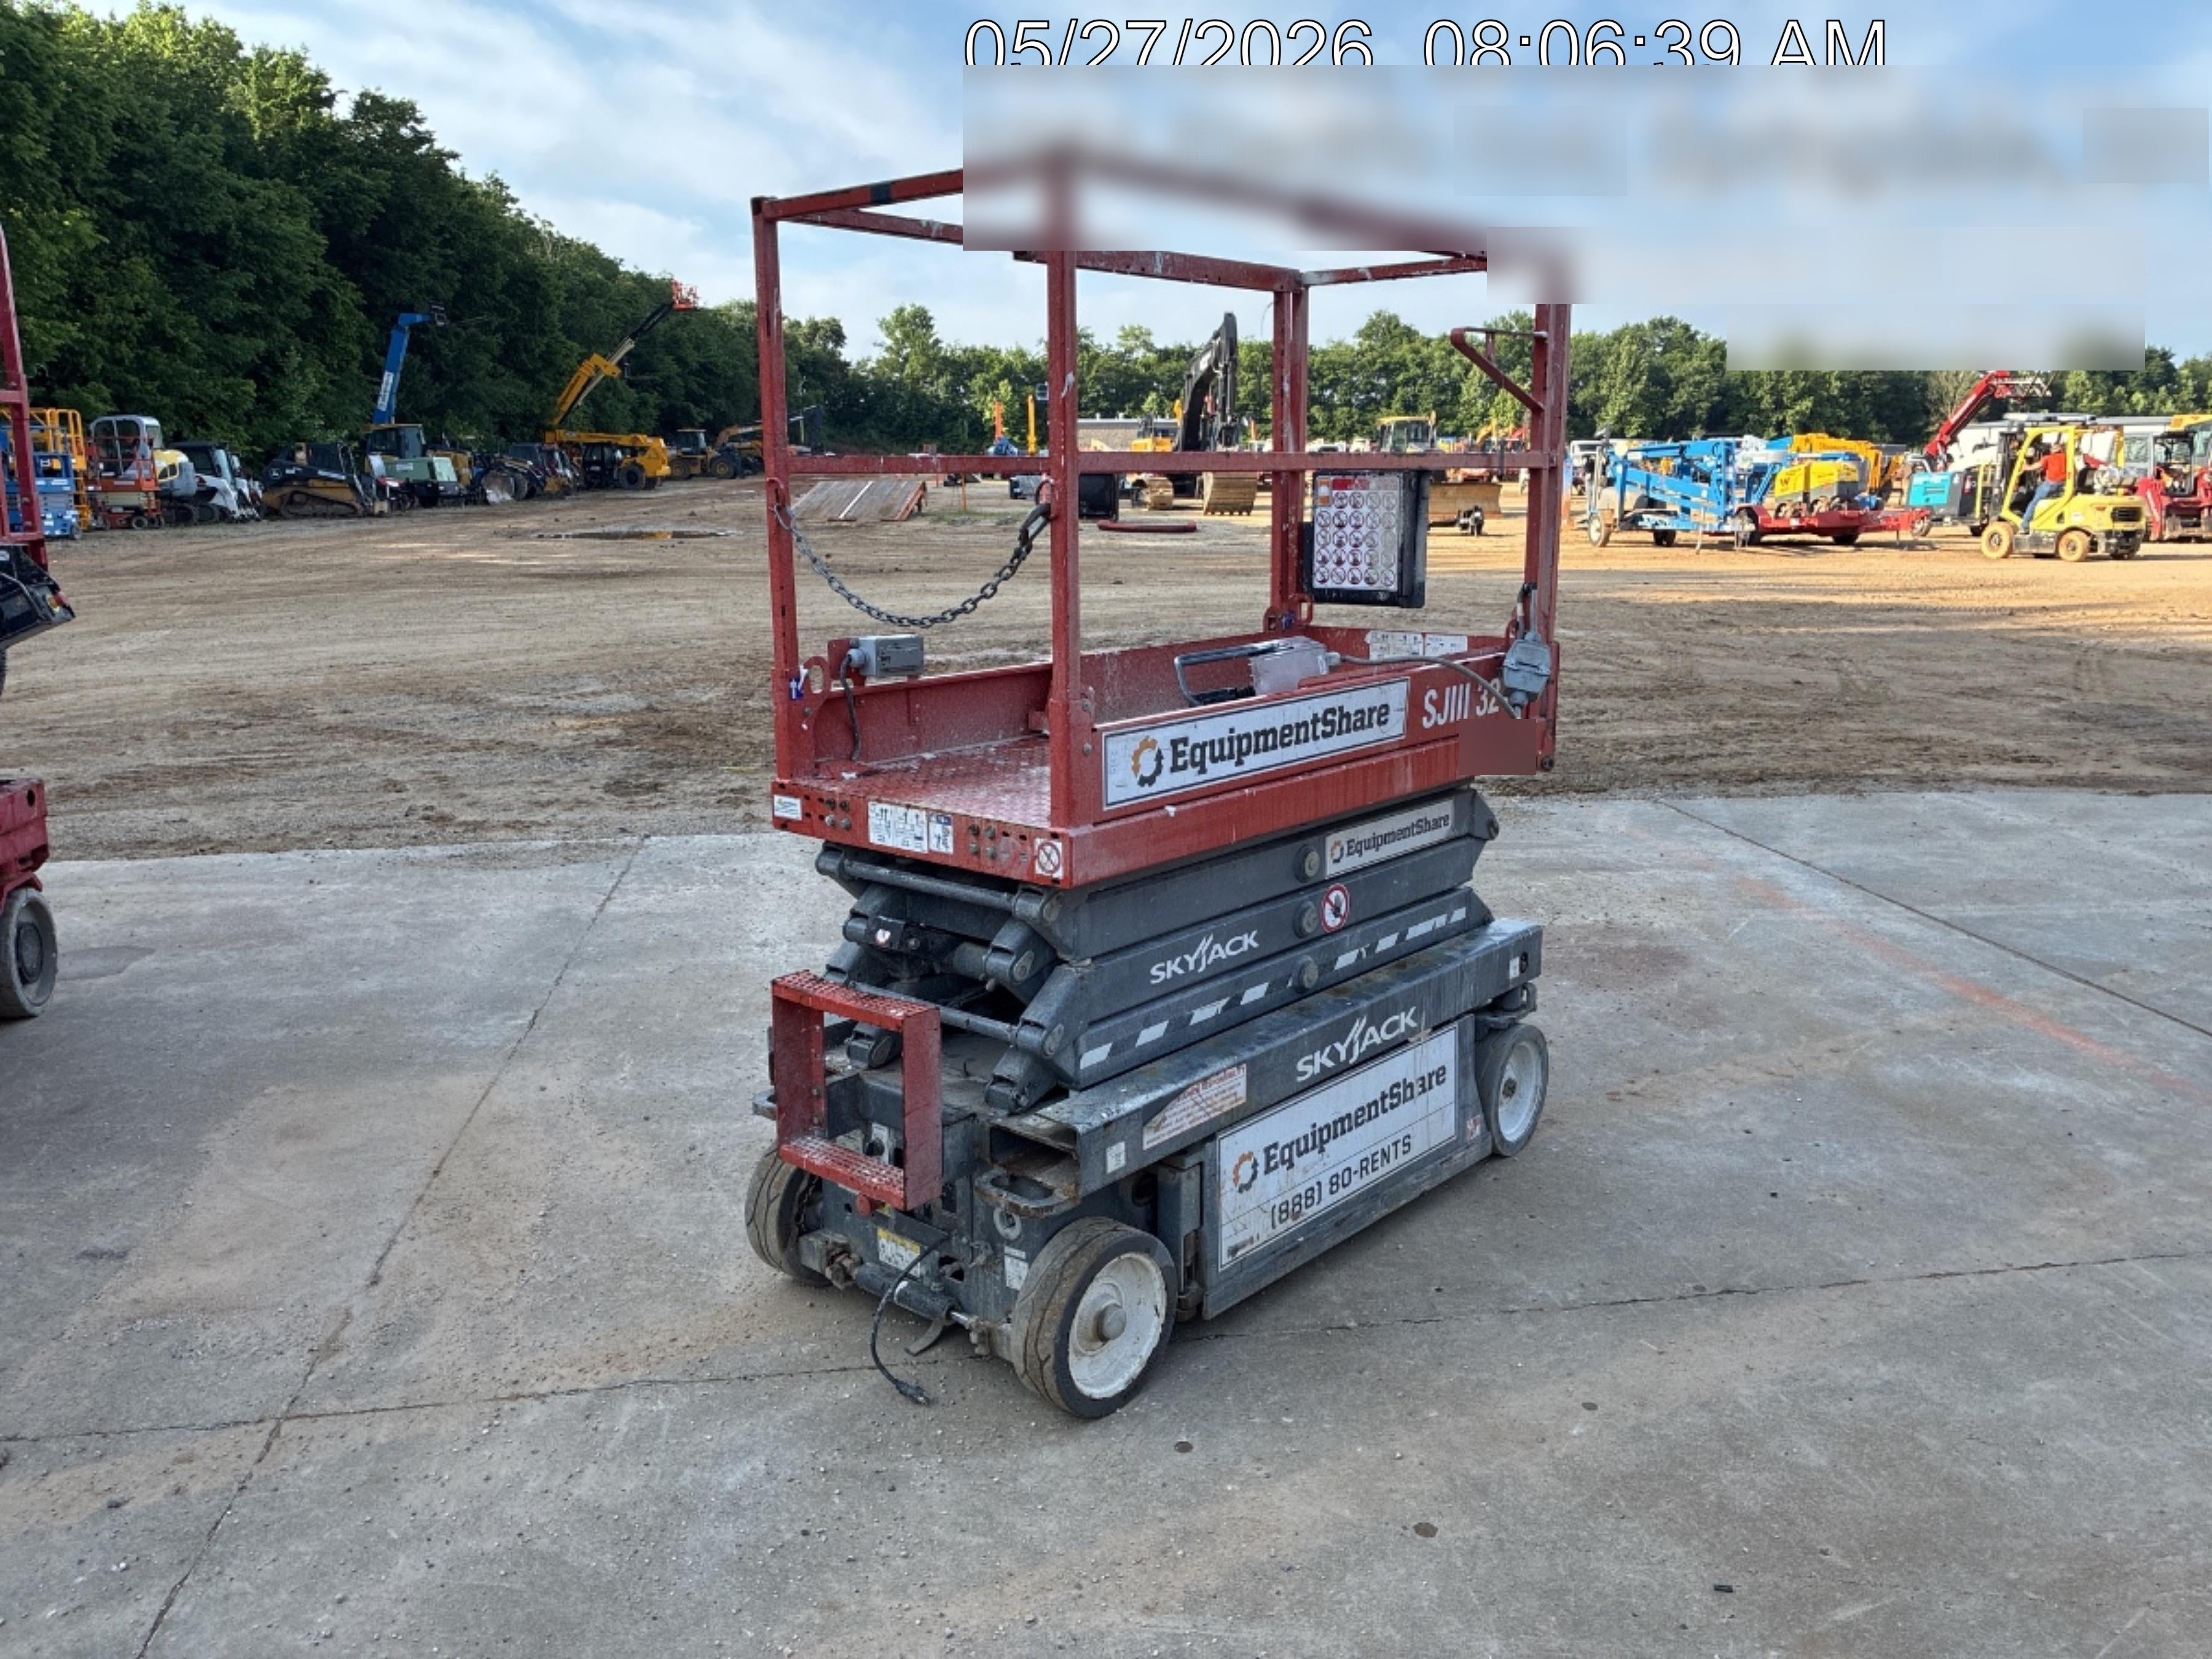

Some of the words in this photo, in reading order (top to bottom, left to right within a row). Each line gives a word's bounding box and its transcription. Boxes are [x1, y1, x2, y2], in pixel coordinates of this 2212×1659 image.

[1169, 702, 1390, 775] EquipmentShare
[1346, 814, 1450, 857] EquipmentShare
[1149, 928, 1260, 985] SKYJACK
[1296, 1005, 1418, 1083] SKYJACK
[1263, 1065, 1447, 1176] EquipmentShare
[1271, 1180, 1322, 1230] (888)
[1328, 1133, 1412, 1196] 80-RENTS
